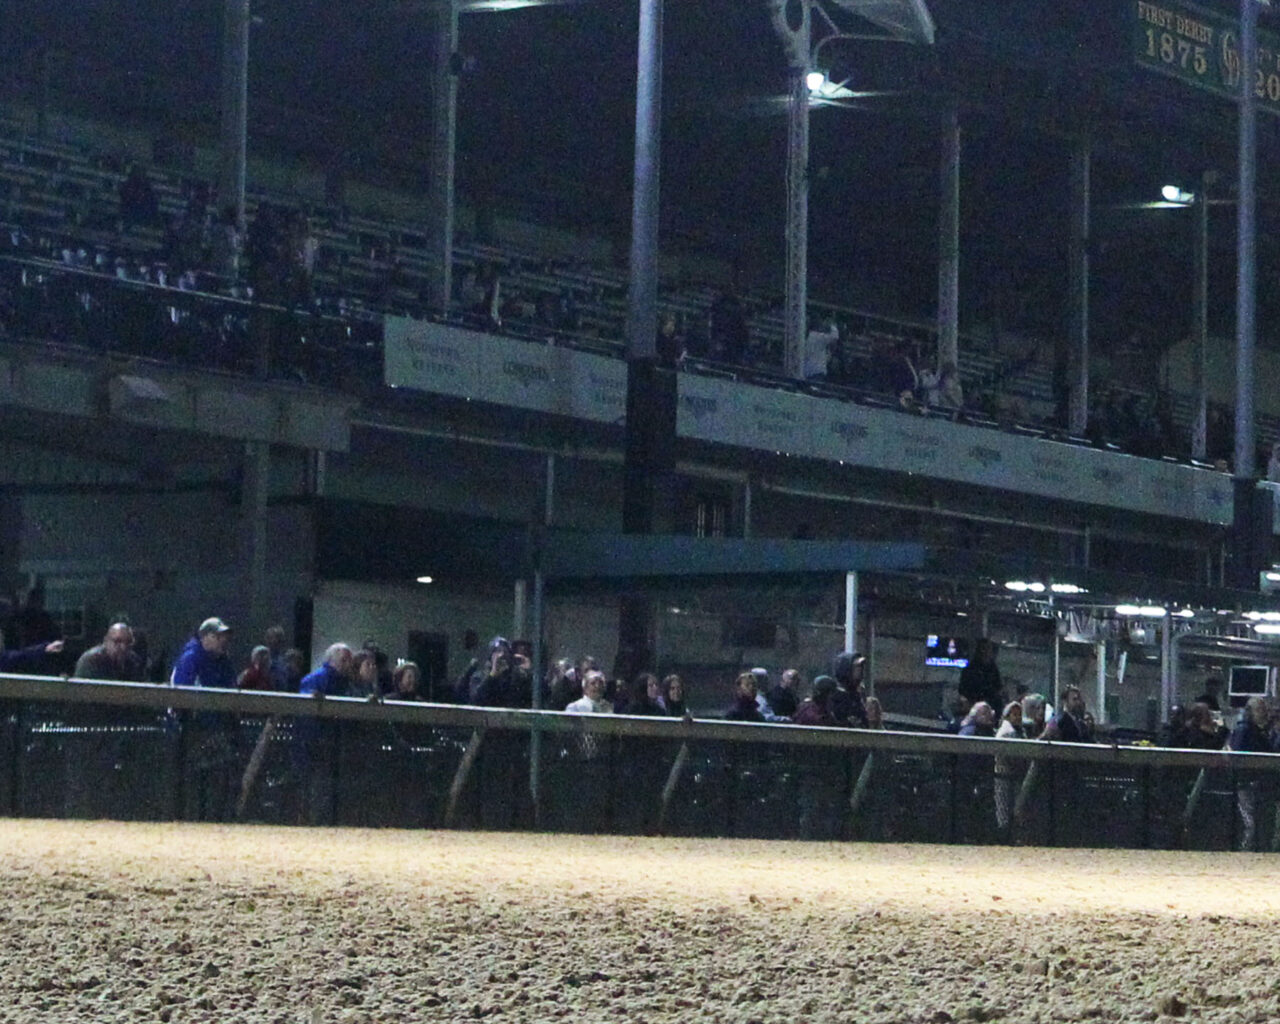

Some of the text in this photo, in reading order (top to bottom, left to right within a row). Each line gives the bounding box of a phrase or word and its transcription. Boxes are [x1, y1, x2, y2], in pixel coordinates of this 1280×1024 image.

[1138, 0, 1213, 45] FIRST DERBY
[1146, 28, 1207, 74] 1875
